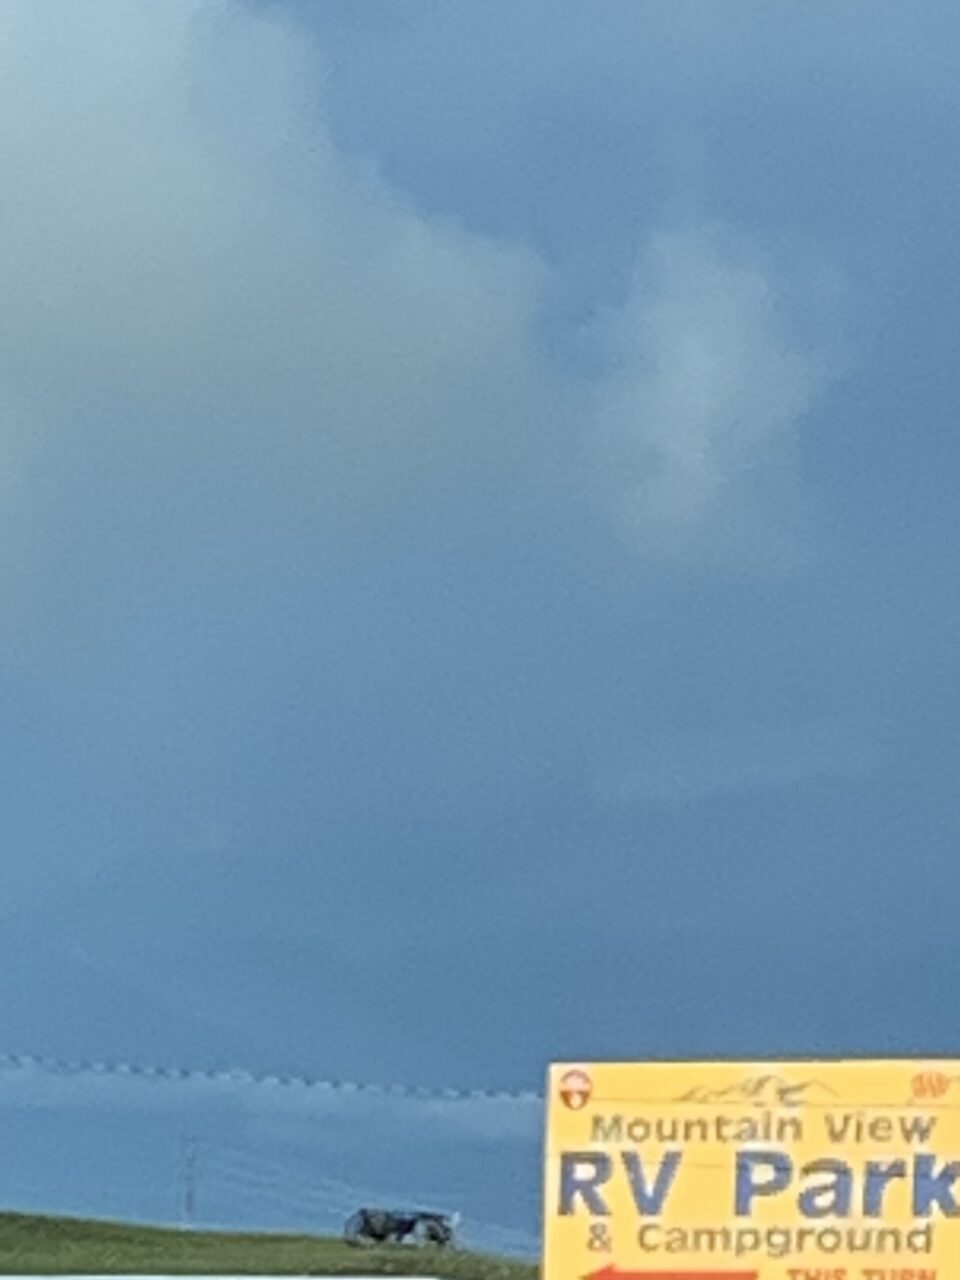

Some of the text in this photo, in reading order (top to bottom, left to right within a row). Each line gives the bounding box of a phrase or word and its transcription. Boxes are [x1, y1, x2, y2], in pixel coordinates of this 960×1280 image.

[590, 1112, 939, 1144] Mountain View
[557, 1150, 683, 1217] RV
[586, 1223, 934, 1258] & Campground
